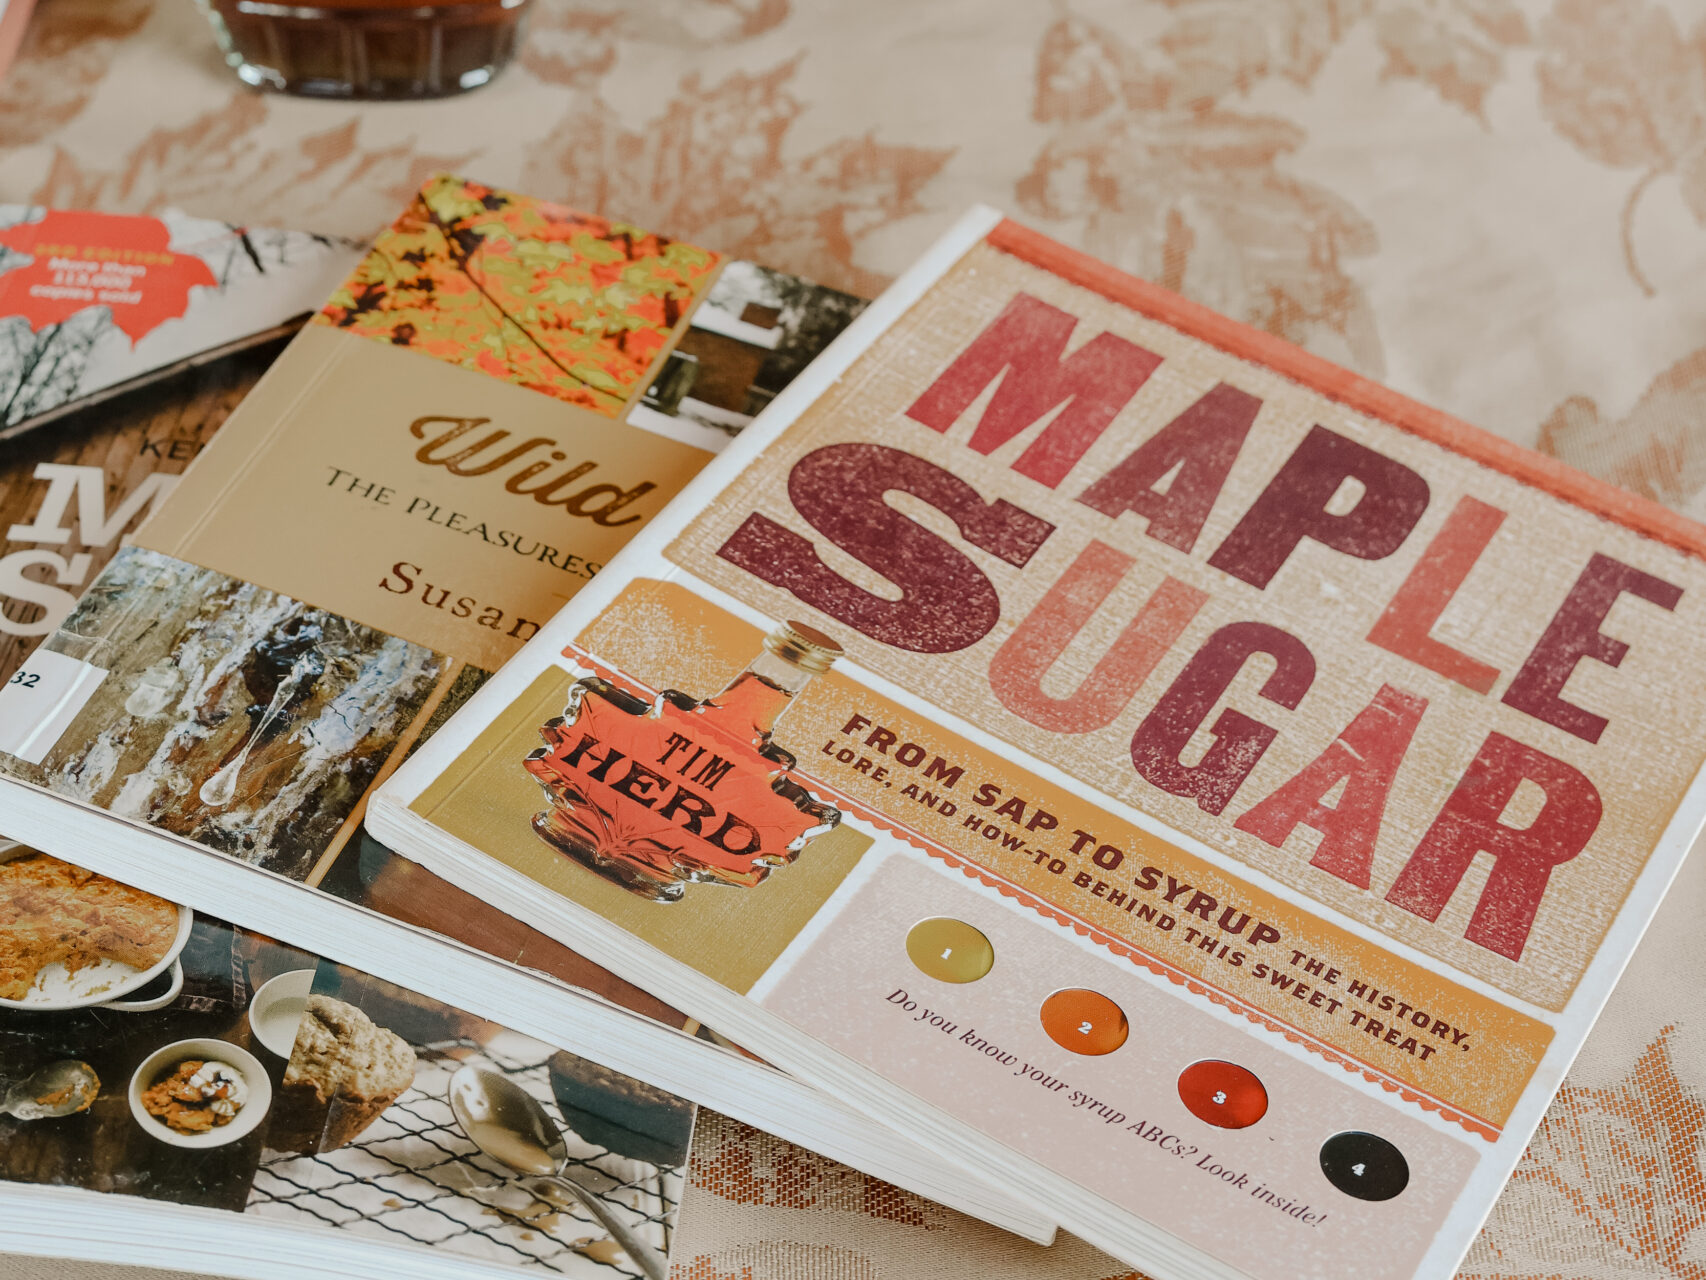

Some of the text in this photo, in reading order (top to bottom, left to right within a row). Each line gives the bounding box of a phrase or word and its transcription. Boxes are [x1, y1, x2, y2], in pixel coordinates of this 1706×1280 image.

[327, 466, 603, 581] THE PLEASURES
[410, 415, 657, 527] Wild
[905, 291, 1685, 745] MAPLE
[379, 561, 540, 642] Susan
[716, 442, 1603, 962] SUGAR
[560, 733, 762, 855] HERD
[656, 732, 736, 791] TIM
[822, 740, 1436, 1061] LORE, AND HOW-TO BEHIND THIS SWEET TREAT
[841, 714, 1471, 1052] FROM SAP TO SYRUP THE HISTORY,
[940, 948, 952, 960] 1
[1077, 1021, 1093, 1035] 2
[885, 989, 1327, 1228] Do you know your syrup ABCs? Look inside!
[1212, 1090, 1227, 1105] 3
[1351, 1163, 1366, 1176] 4
